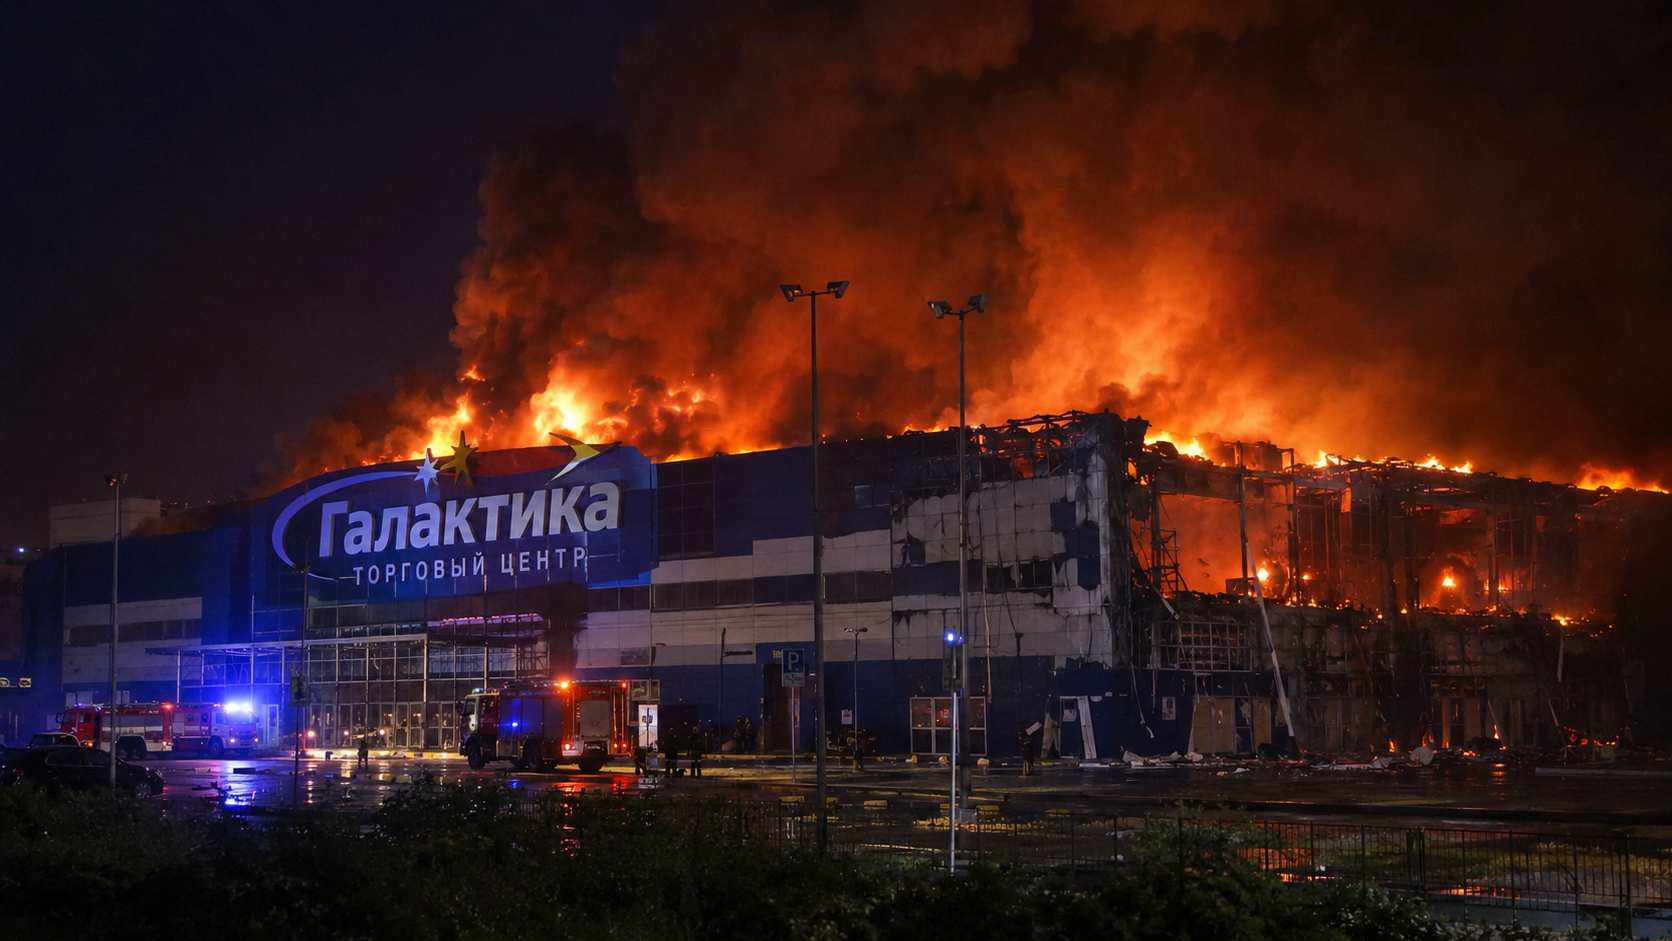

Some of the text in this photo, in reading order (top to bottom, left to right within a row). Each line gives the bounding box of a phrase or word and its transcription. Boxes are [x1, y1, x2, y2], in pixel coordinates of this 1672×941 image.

[318, 481, 622, 558] Галактика
[352, 546, 588, 586] ТОРГОВЫЙ ЦЕНТР
[788, 651, 800, 671] P
